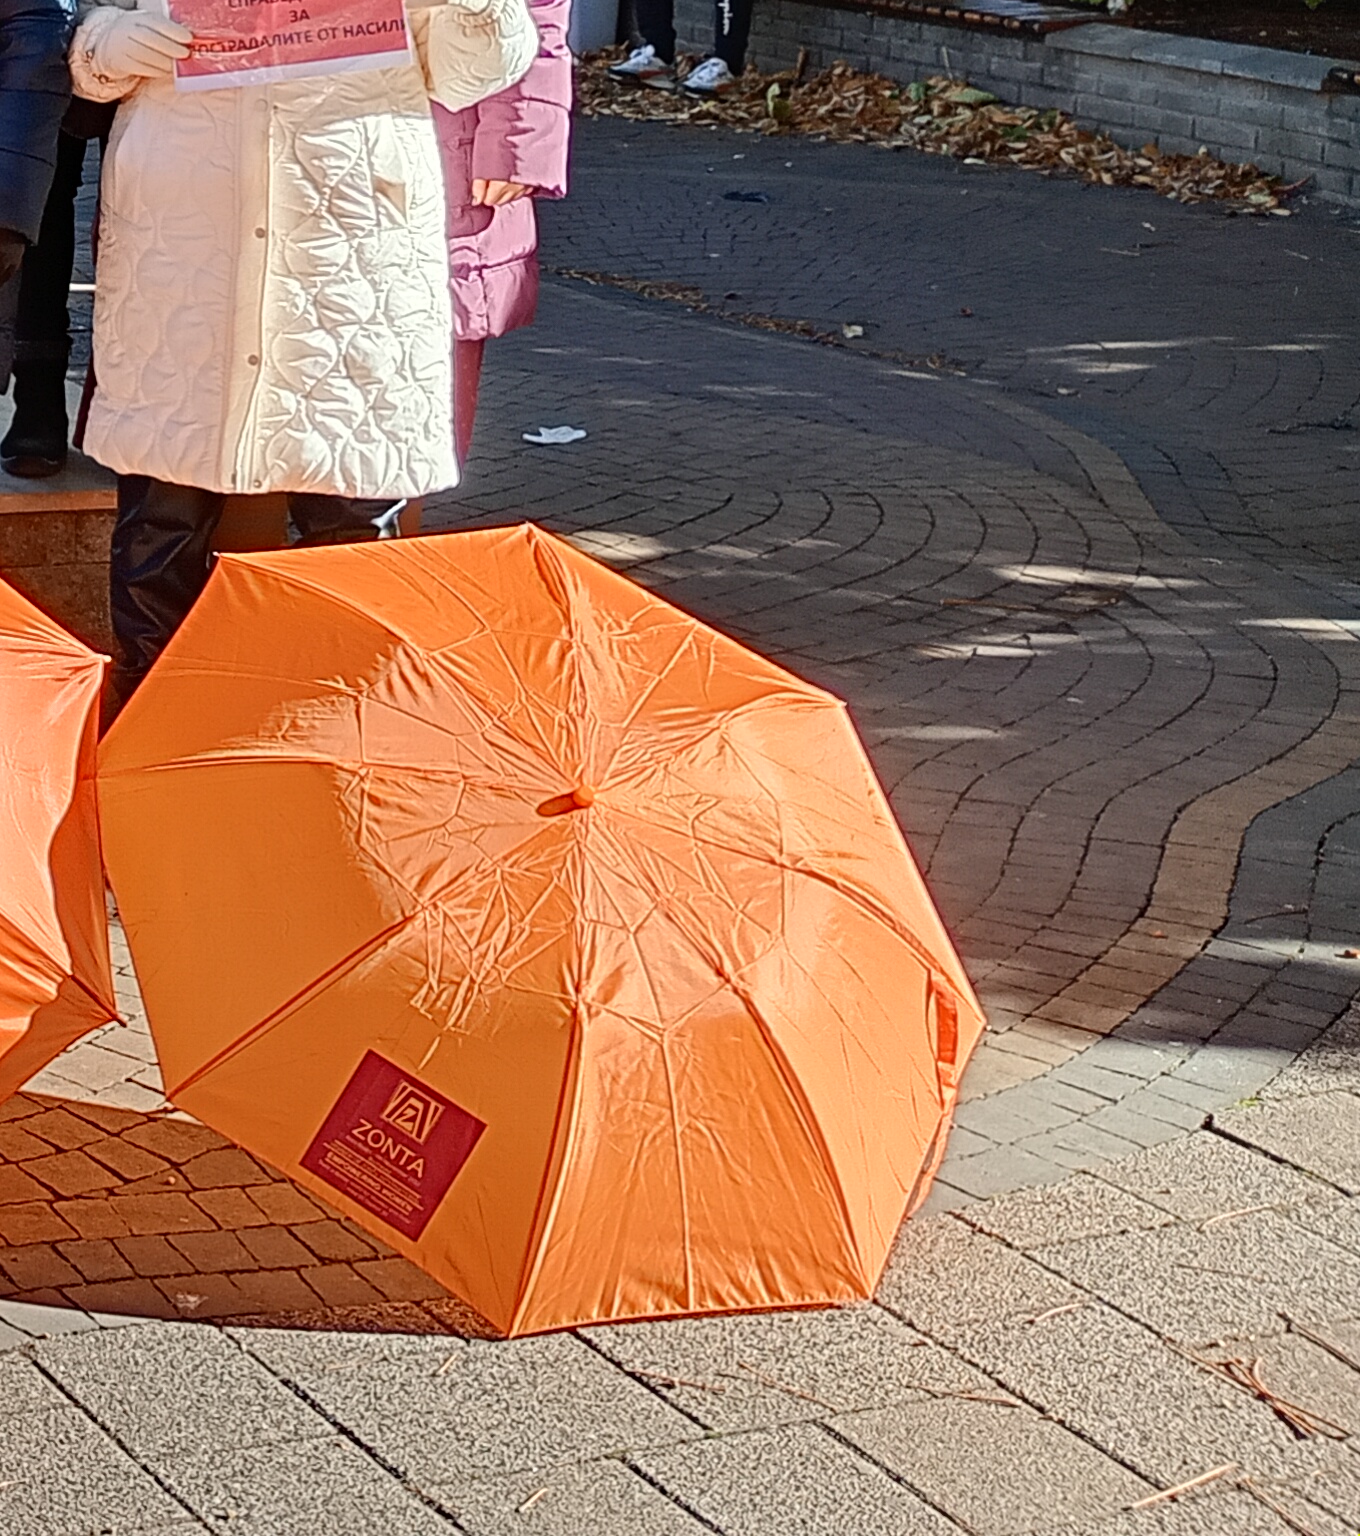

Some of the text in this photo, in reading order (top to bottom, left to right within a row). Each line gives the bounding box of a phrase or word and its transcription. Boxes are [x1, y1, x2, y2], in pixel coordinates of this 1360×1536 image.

[289, 9, 310, 24] ЗА
[317, 27, 339, 42] ОТ
[351, 1118, 425, 1179] ZONTA
